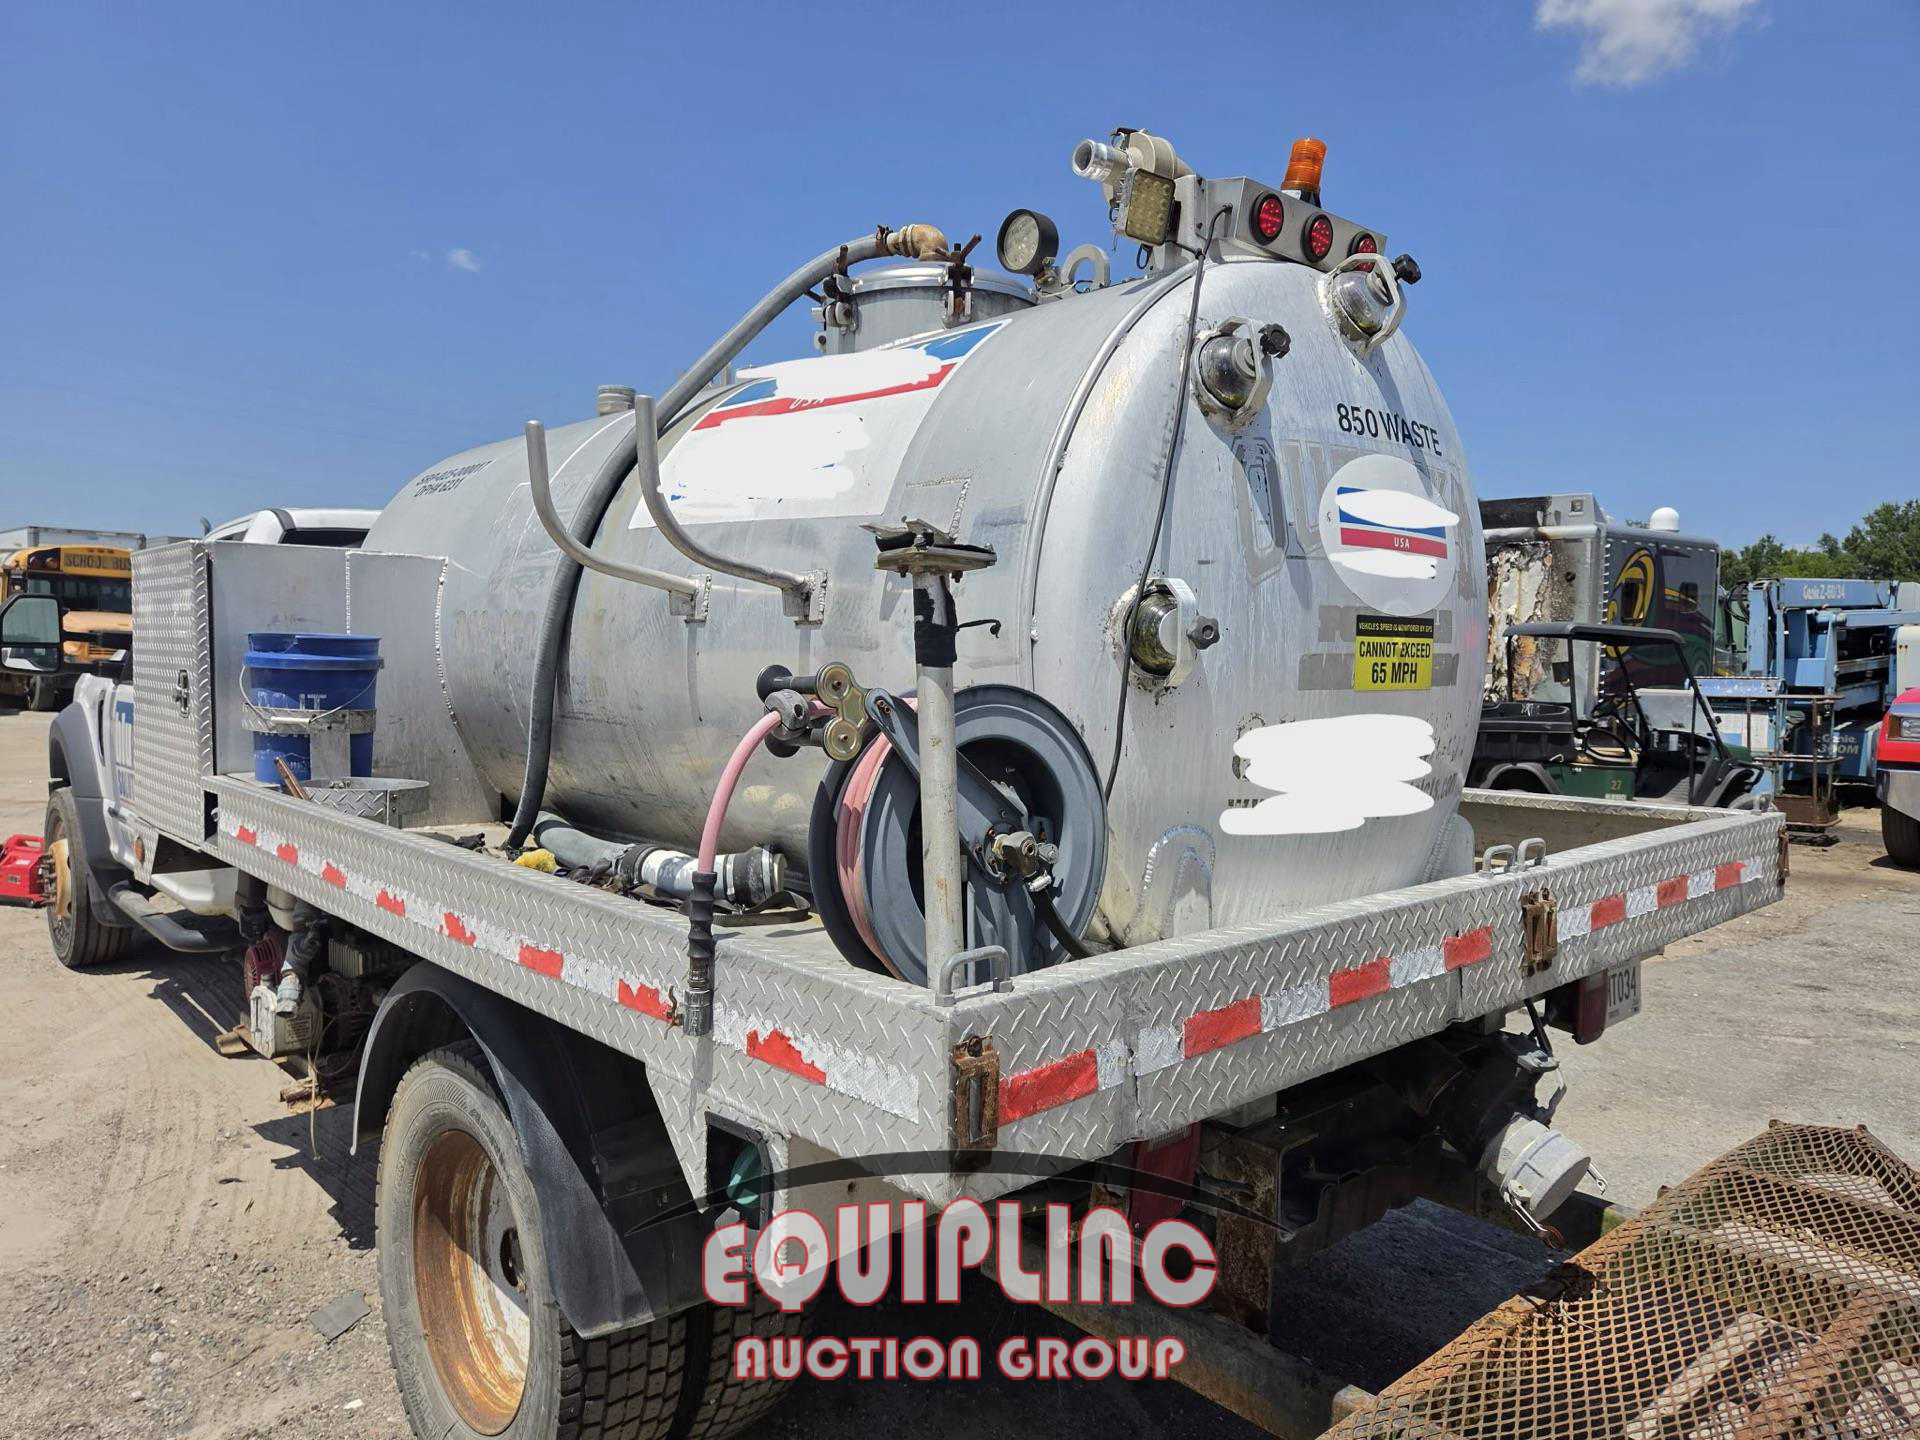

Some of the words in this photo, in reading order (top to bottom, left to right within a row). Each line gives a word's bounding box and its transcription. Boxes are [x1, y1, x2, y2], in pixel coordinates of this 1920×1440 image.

[1337, 403, 1379, 438] 850
[1379, 411, 1442, 456] WASTE
[1394, 537, 1410, 549] USA
[64, 553, 110, 569] SCHOOL
[1380, 623, 1392, 631] SPEED
[1359, 640, 1398, 658] CANNOT
[1400, 642, 1431, 659] EXCEED
[1371, 661, 1387, 684] 65
[1390, 661, 1418, 684] MPH
